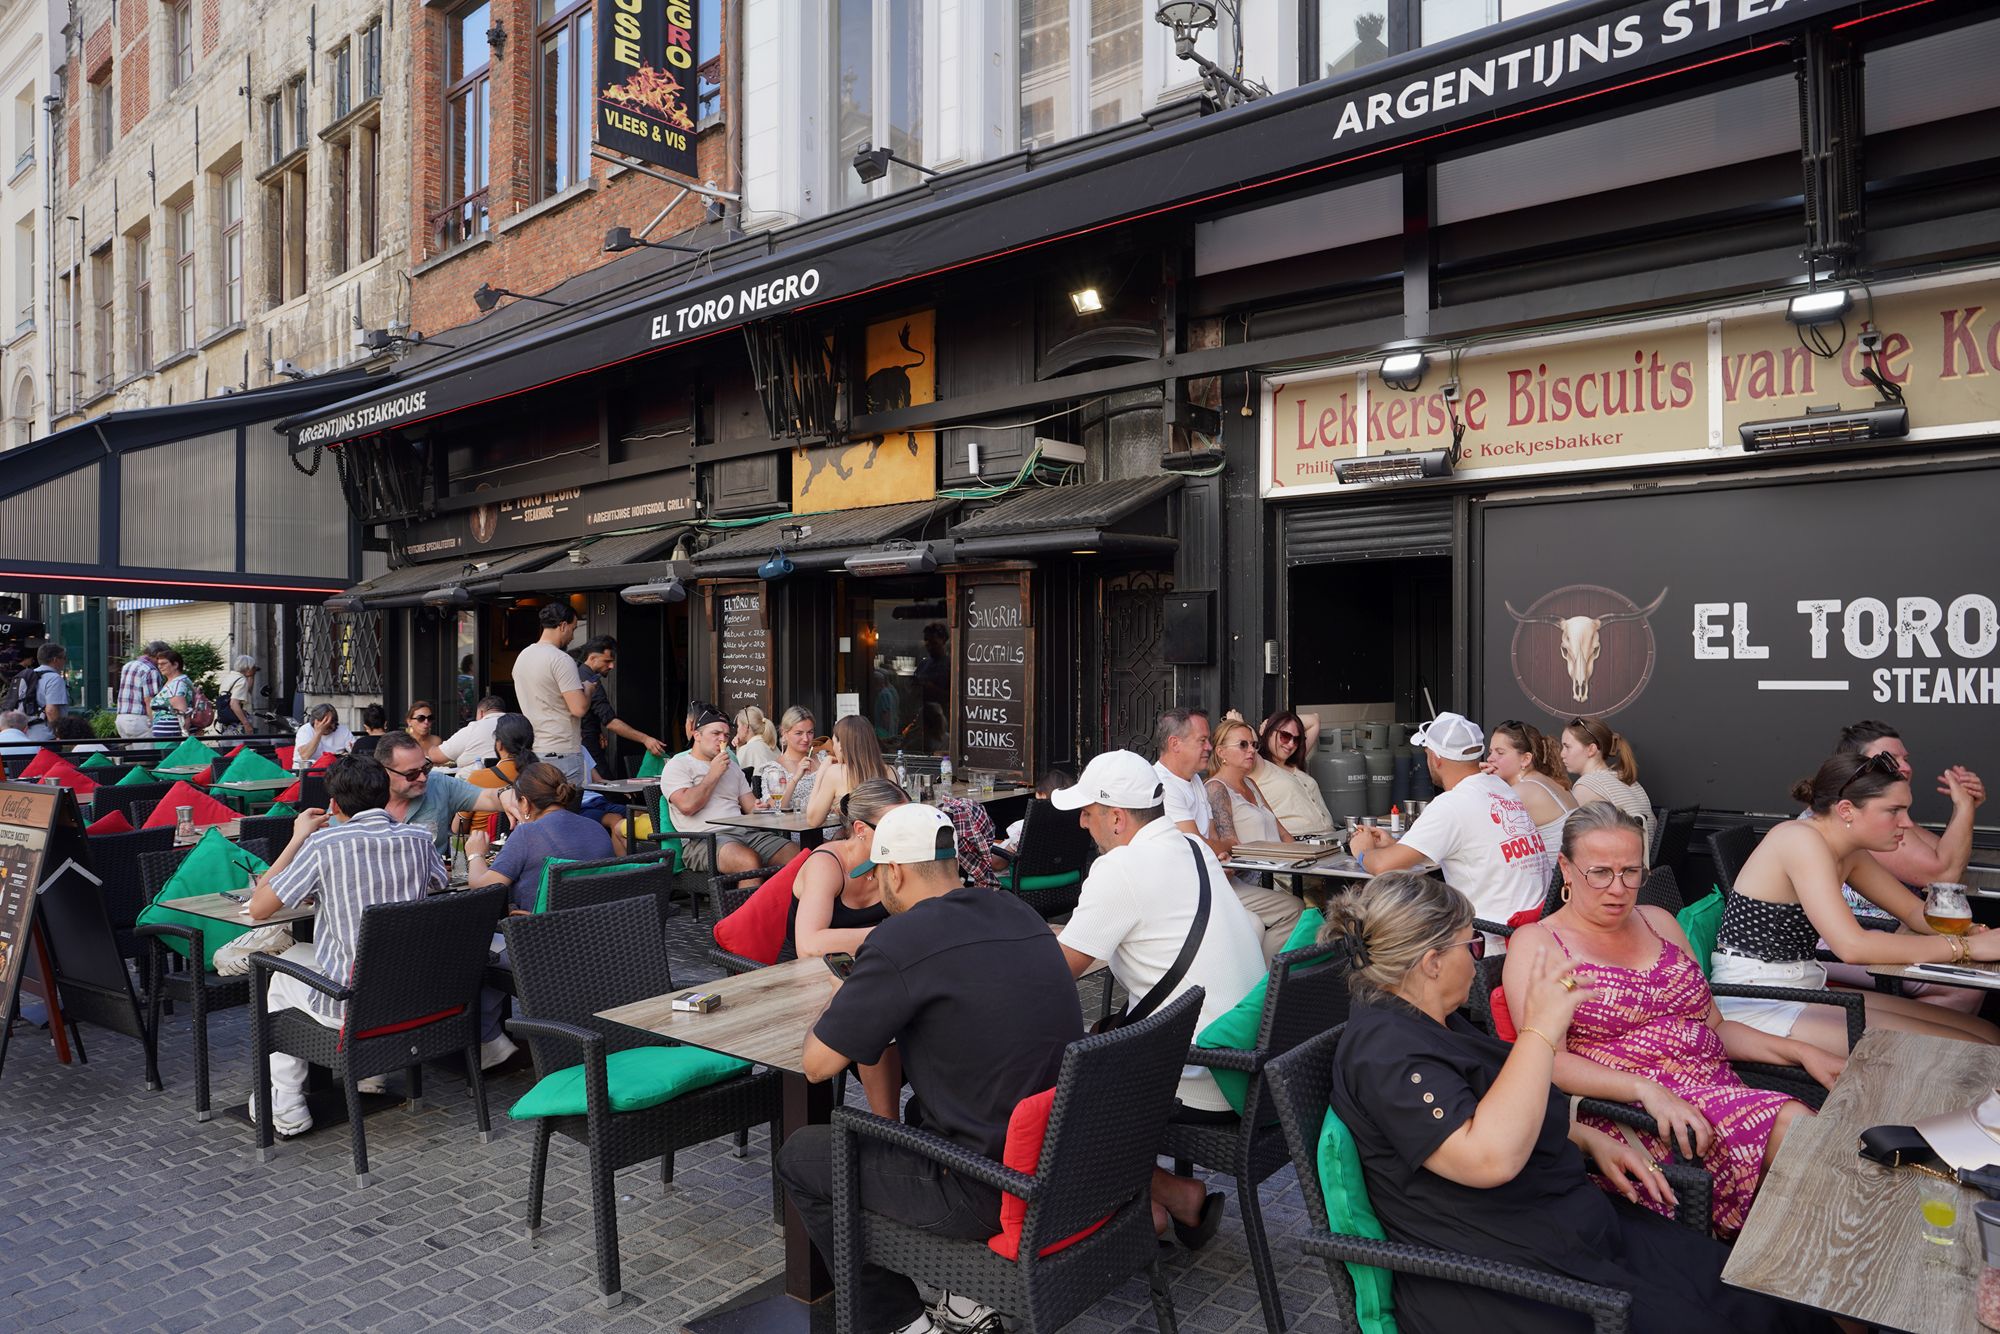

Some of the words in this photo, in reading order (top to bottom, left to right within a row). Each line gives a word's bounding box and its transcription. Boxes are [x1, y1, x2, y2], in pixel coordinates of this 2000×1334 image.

[1332, 15, 1644, 140] ARGENTIJNS
[1661, 0, 1809, 44] STE
[604, 108, 648, 138] VLEES
[651, 126, 662, 143] &
[665, 129, 687, 151] VIS
[651, 314, 671, 341] EL
[676, 294, 735, 333] TORO
[739, 268, 820, 315] NEGRO
[1507, 350, 1694, 427] Biscuits
[1723, 346, 1816, 402] van
[298, 412, 356, 445] ARGENTIJNS
[356, 391, 427, 429] STEAKHOUSE
[1480, 432, 1623, 459] Koekjesbakker
[524, 505, 554, 522] STEAKHOUSE
[667, 498, 685, 512] GRILL
[1692, 602, 1770, 660] EL
[1797, 593, 2000, 660] TORO
[967, 677, 1012, 700] BEERS
[1872, 667, 2000, 704] STEAKH
[1501, 836, 1536, 863] POOL
